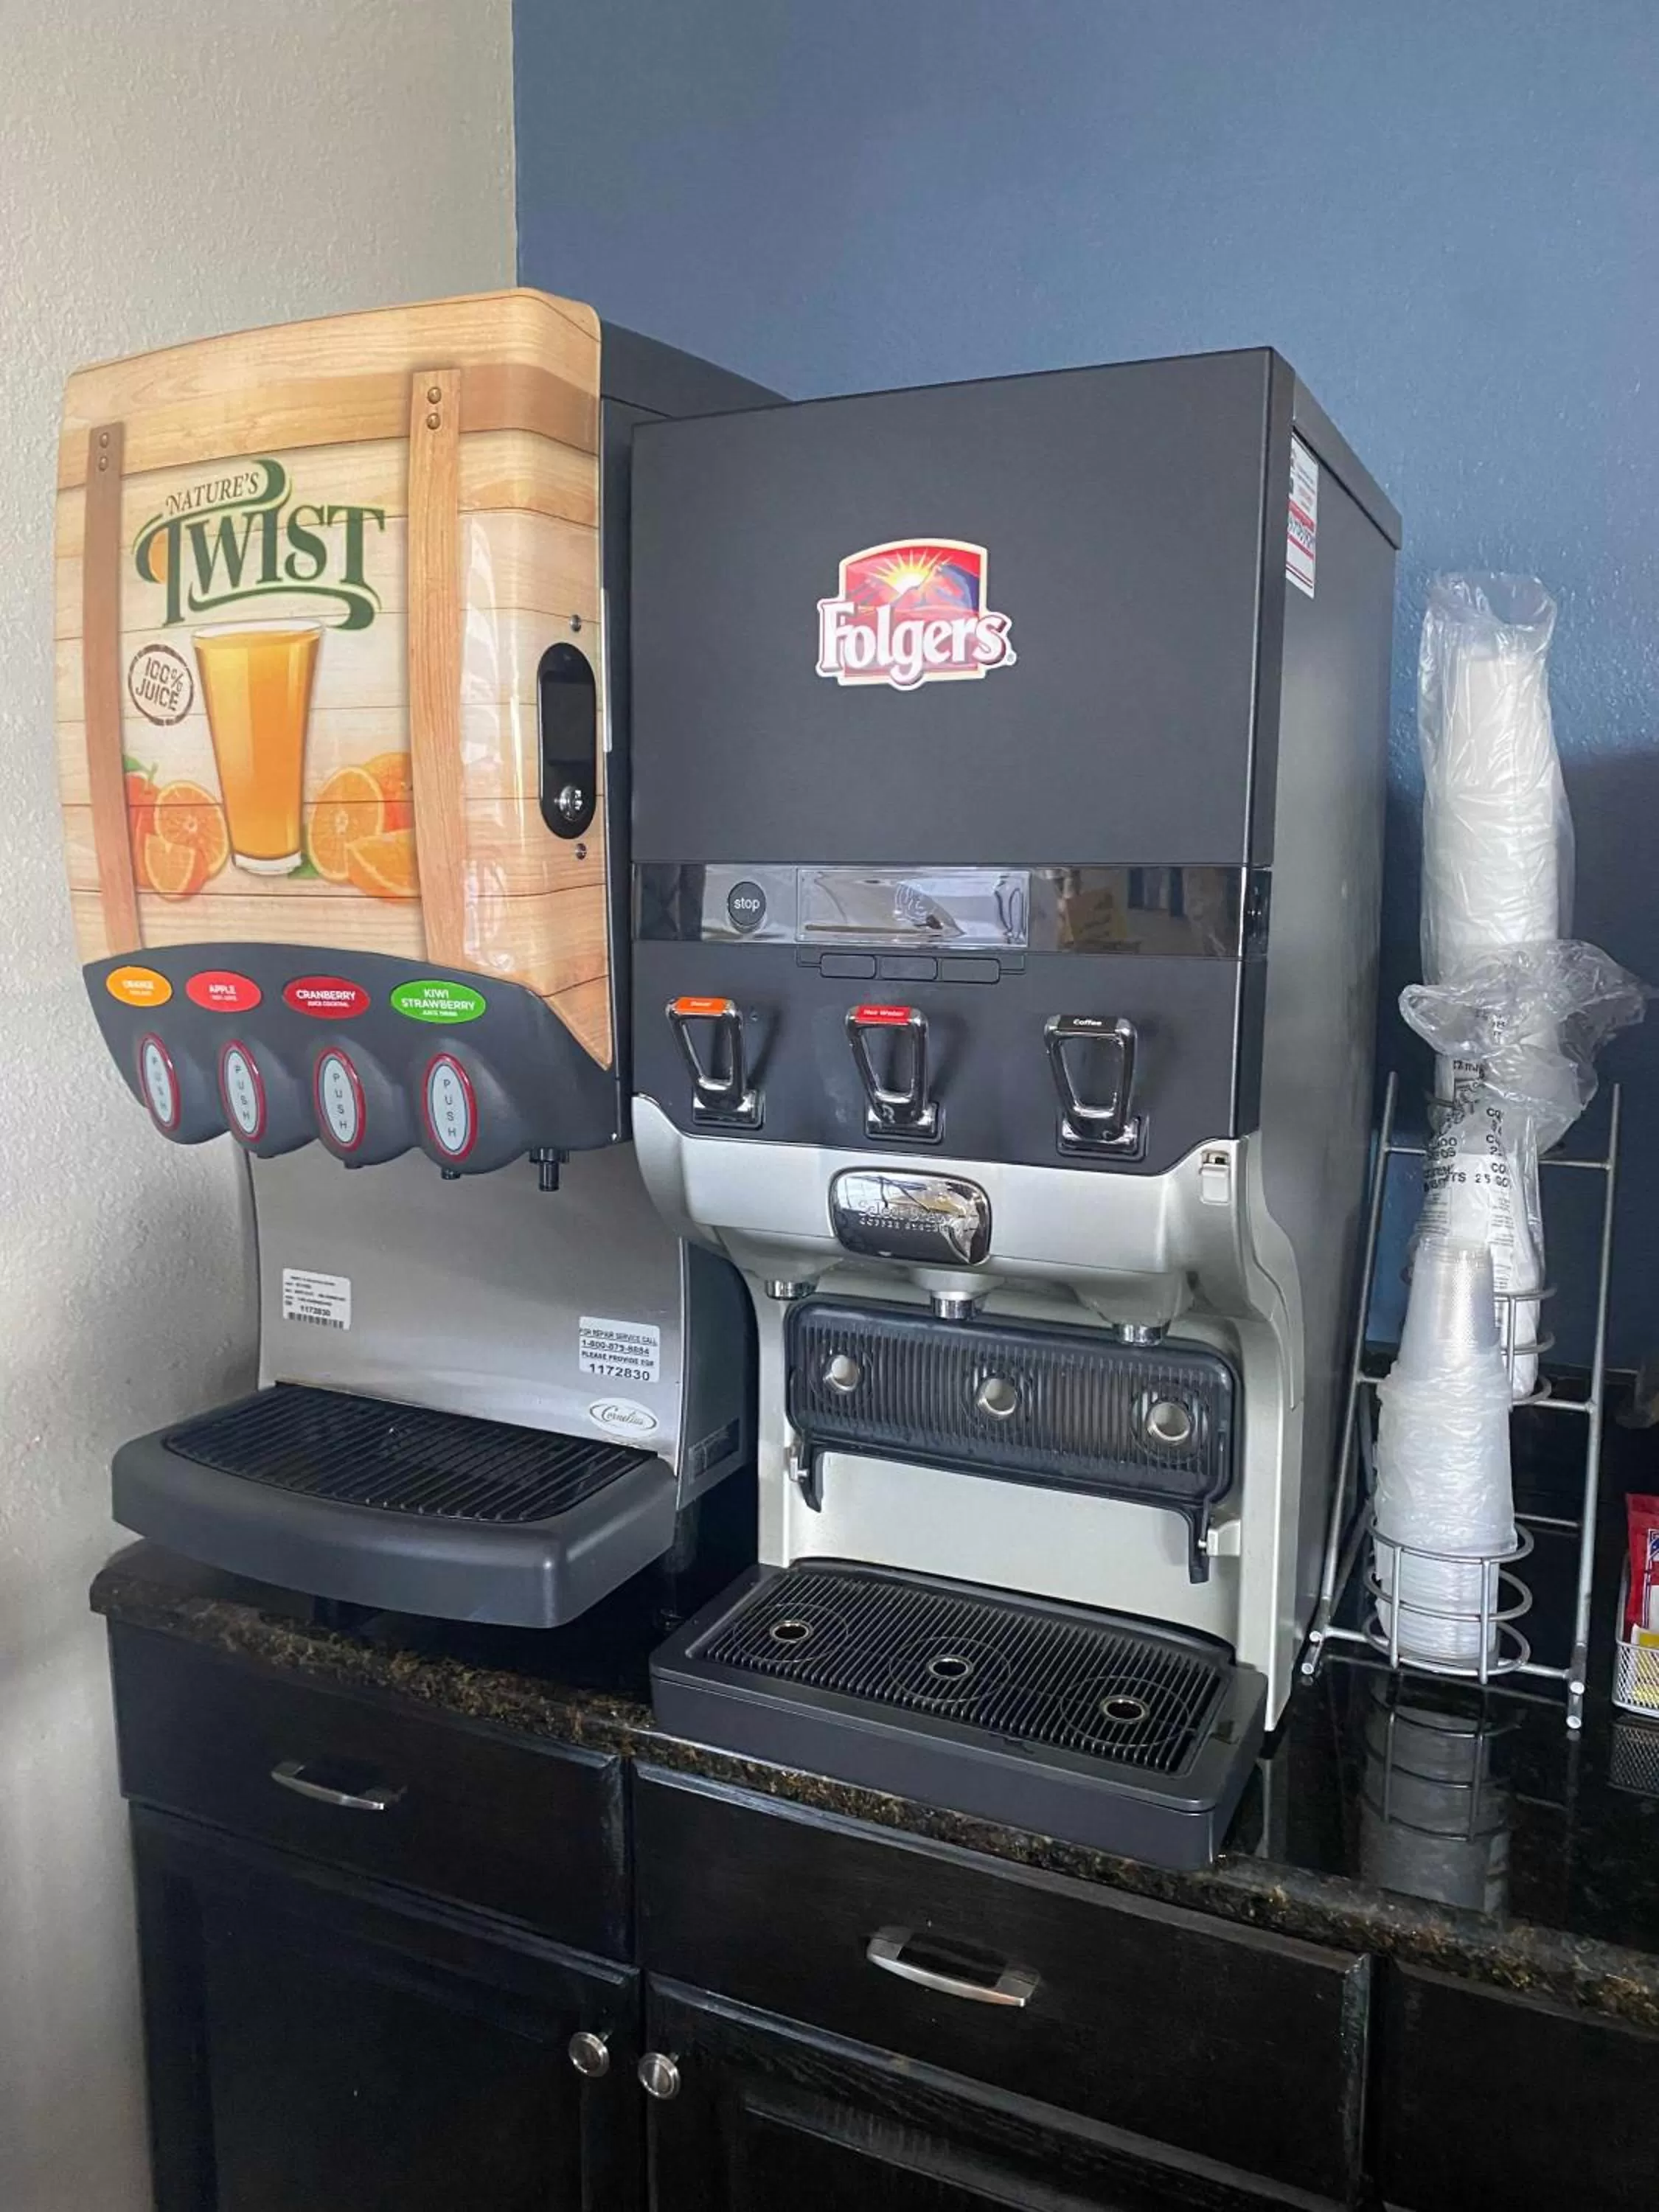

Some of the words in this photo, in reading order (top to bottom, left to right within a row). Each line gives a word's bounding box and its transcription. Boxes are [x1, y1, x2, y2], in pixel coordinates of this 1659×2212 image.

[166, 472, 260, 515] NATURE'S
[135, 459, 386, 629] TWIST
[818, 601, 1008, 686] Folgers
[145, 657, 184, 692] 100%
[135, 678, 179, 712] JUICE
[734, 897, 760, 913] stop
[296, 990, 355, 1001] CRANBERRY
[401, 998, 476, 1011] STRAWBERRY
[425, 988, 449, 998] KIWI
[1073, 1018, 1103, 1027] Coffee
[333, 1073, 347, 1129] PUSH
[443, 1079, 457, 1138] PUSH
[581, 1350, 607, 1360] PLEASE
[608, 1354, 639, 1365] PROVIDE
[589, 1363, 650, 1381] 1172830
